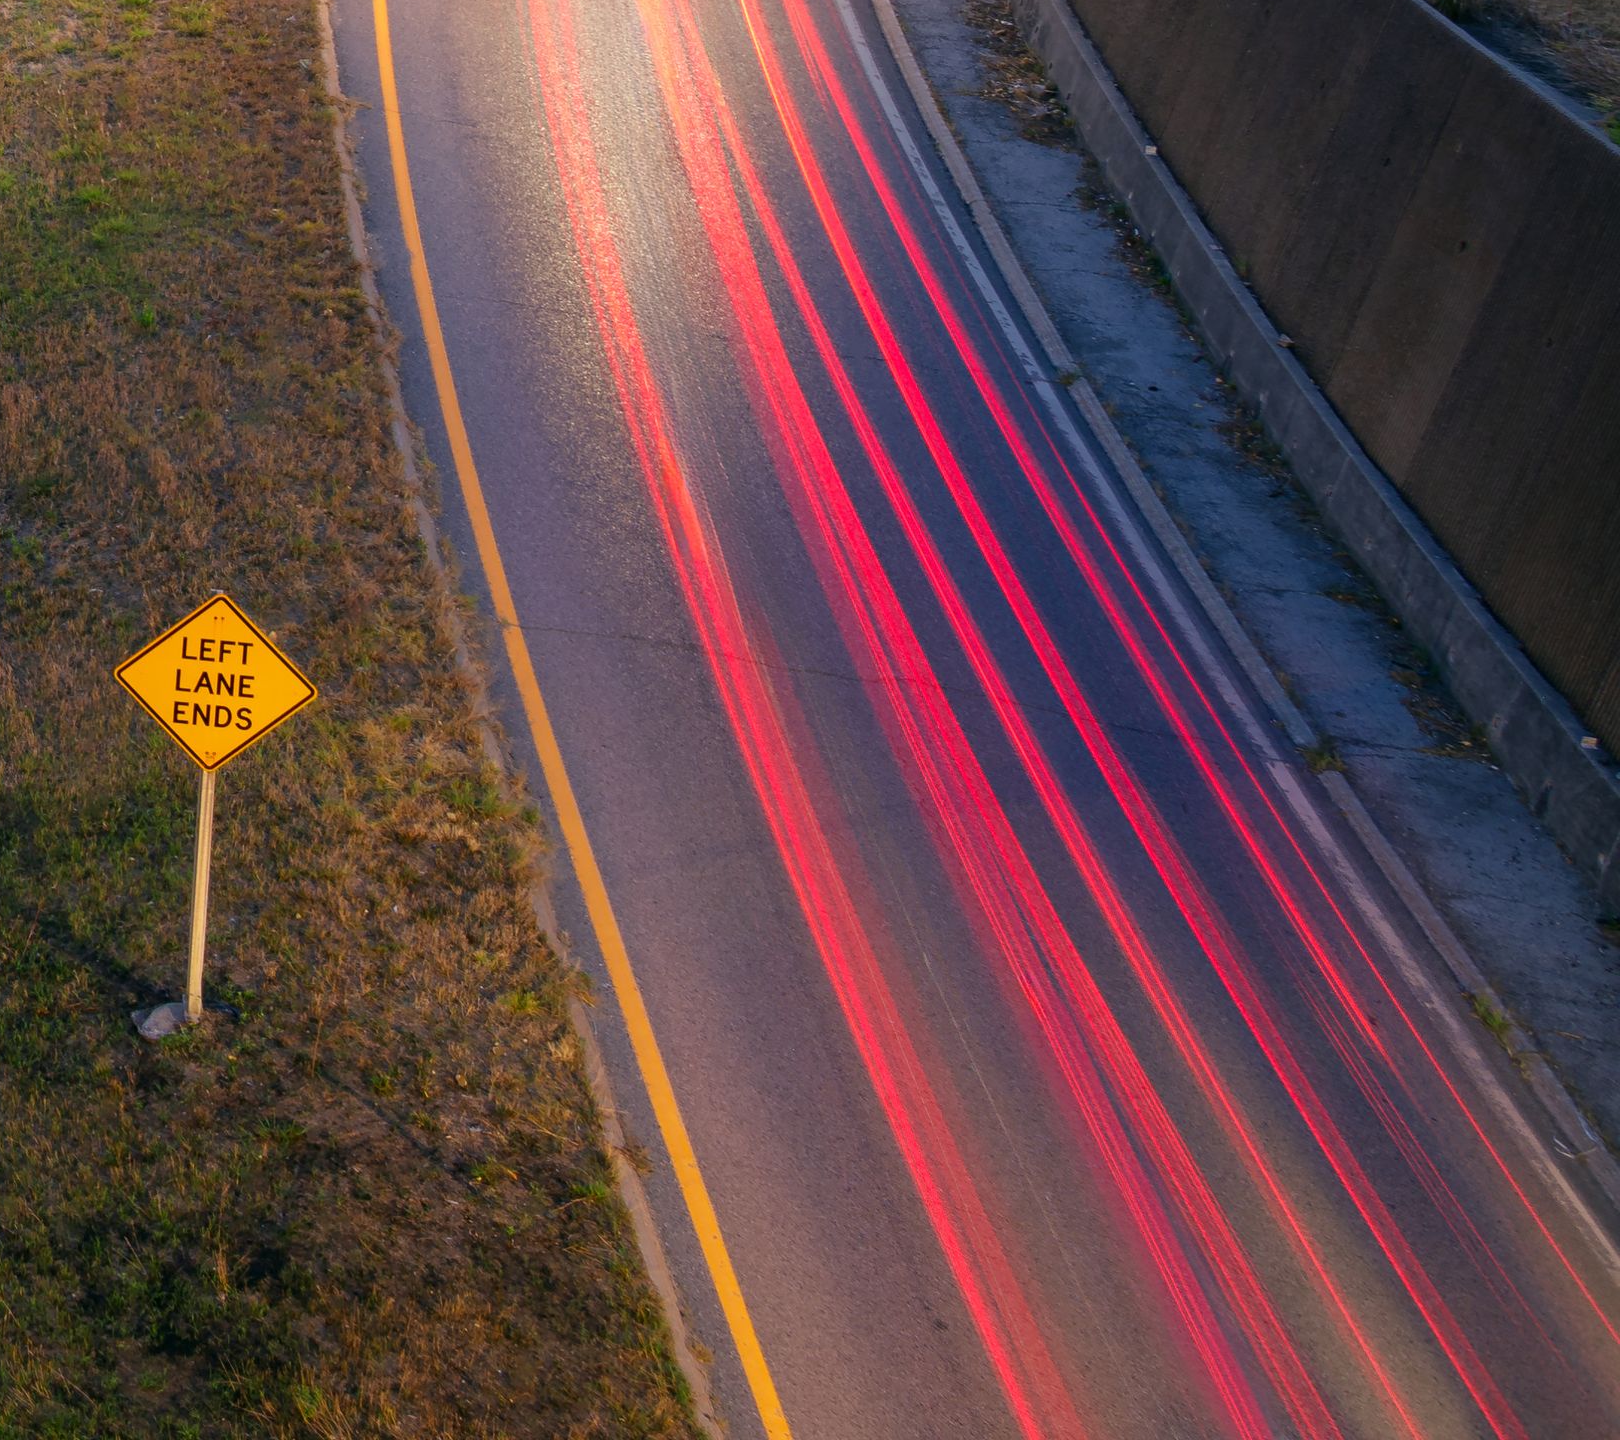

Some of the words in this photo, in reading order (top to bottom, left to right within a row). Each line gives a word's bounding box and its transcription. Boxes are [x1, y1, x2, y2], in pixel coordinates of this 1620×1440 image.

[182, 637, 254, 665] LEFT
[175, 668, 255, 698] LANE
[173, 701, 253, 730] ENDS
